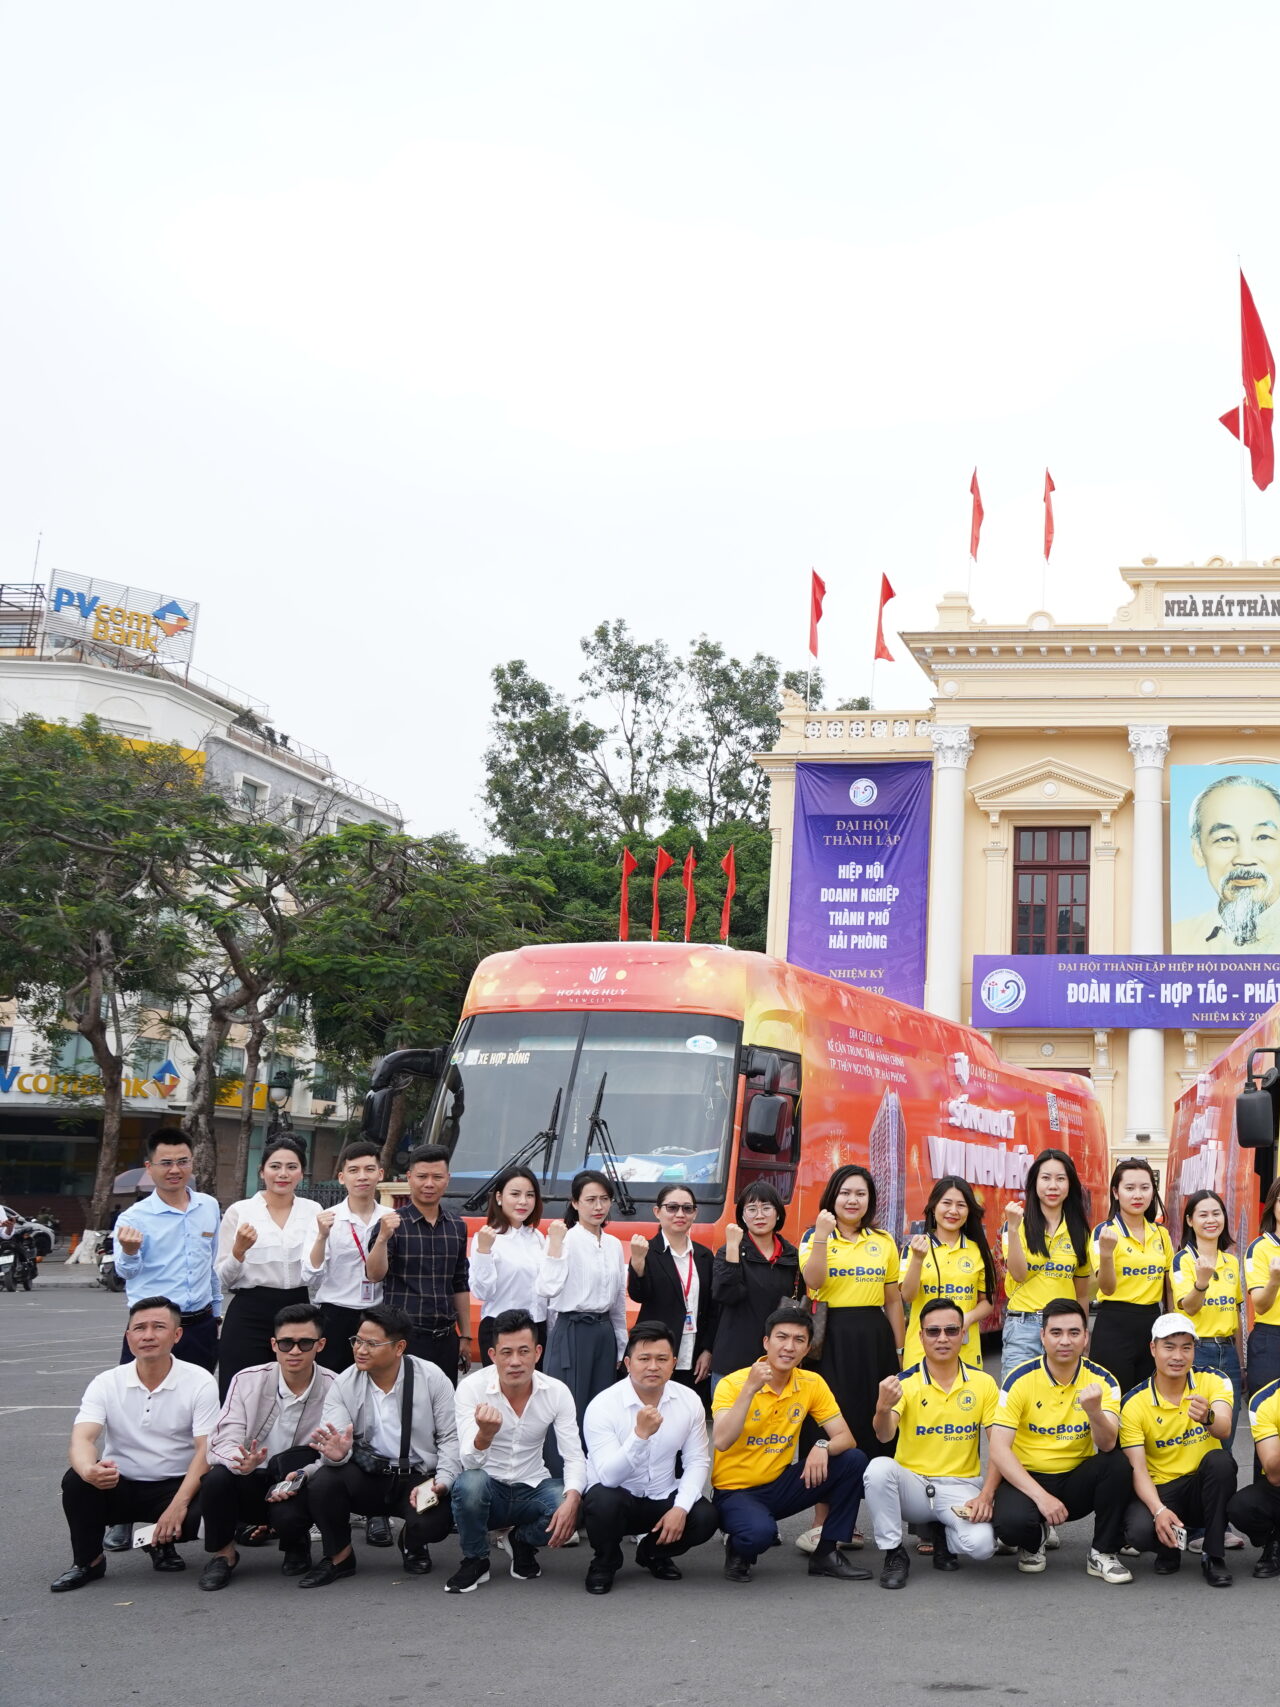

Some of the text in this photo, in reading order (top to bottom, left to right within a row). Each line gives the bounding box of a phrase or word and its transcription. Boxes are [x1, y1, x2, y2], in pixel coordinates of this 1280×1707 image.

[1165, 595, 1199, 617] NHÀ
[1202, 595, 1235, 617] HÁT
[92, 620, 159, 653] Bank
[836, 819, 889, 834] ĐẠI HỘI
[823, 834, 901, 848] THÀNH LẬP
[838, 861, 884, 882] HIỆP HỘI
[821, 884, 899, 905] DOANH NGHIỆP
[829, 908, 891, 926] THÀNH PHỐ
[829, 931, 887, 950] HẢI PHÒNG
[829, 967, 867, 980] NHIỆM
[1058, 962, 1077, 973] ĐẠI
[1080, 961, 1101, 973] HỘI
[1103, 961, 1143, 971] THÀNH
[1145, 961, 1166, 973] LẬP
[1168, 961, 1194, 973] HIỆP
[1197, 961, 1218, 973] HỘI
[1220, 962, 1261, 971] DOANH
[556, 987, 628, 996] HOANG HUY
[1067, 978, 1110, 1004] ĐOÀN
[1115, 978, 1144, 1004] KẾT
[1160, 981, 1193, 1008] HỢP
[1197, 978, 1228, 1004] TÁC
[1192, 1011, 1247, 1022] NHIỆM KỲ
[478, 1053, 489, 1065] XE
[489, 1052, 506, 1067] HỢP
[829, 1266, 887, 1278] RecBook
[1122, 1265, 1167, 1276] RecBo
[923, 1283, 975, 1294] RecBook
[916, 1421, 979, 1436] RecBook
